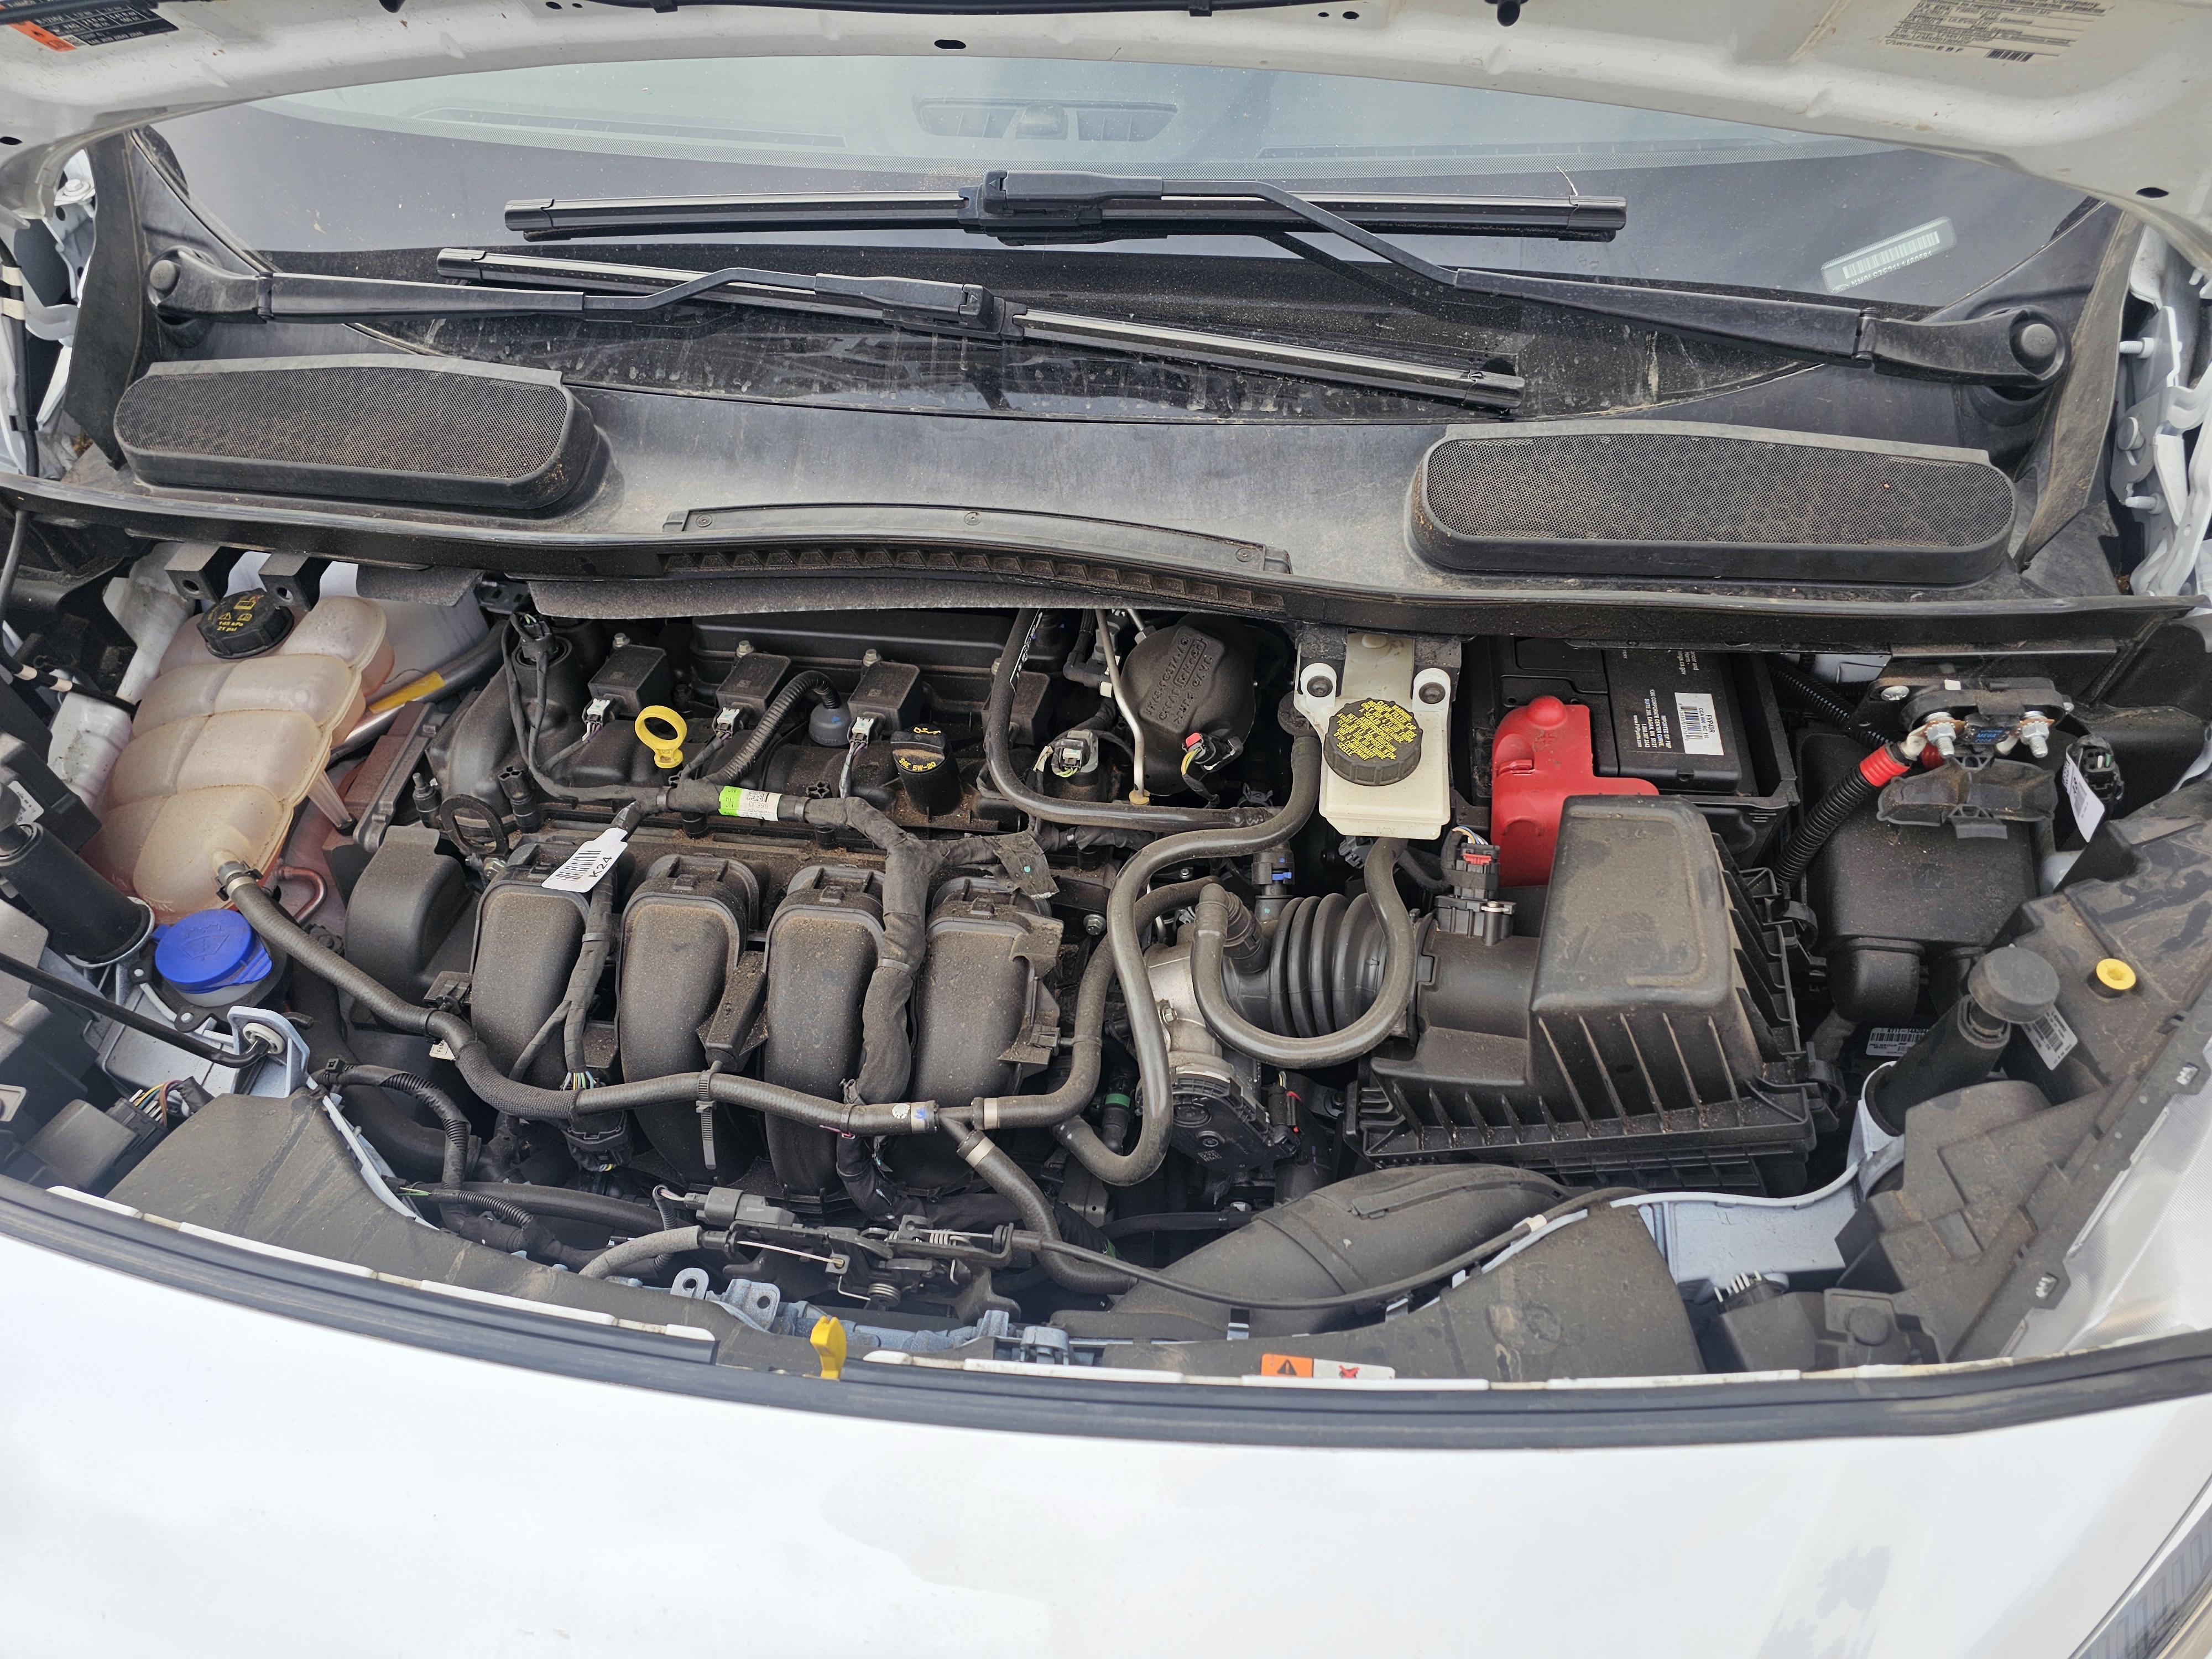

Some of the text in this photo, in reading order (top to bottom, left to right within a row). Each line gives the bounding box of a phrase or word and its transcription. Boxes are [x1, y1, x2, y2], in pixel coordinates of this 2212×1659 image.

[1337, 713, 1353, 724] AVANT
[1364, 712, 1381, 725] SEALED
[1377, 701, 1392, 712] CLEAN
[1391, 711, 1407, 724] FILLER
[1651, 697, 1660, 718] CORPORATE
[1361, 703, 1374, 712] ONLY
[1373, 711, 1383, 719] DOT
[1386, 722, 1400, 733] FLUID
[1399, 732, 1413, 743] FROM
[1368, 700, 1385, 714] BEFORE
[1406, 730, 1417, 739] USE
[1706, 714, 1715, 733] FVP40R
[1337, 719, 1354, 734] PLOYER
[1353, 732, 1363, 741] QUE
[1369, 745, 1387, 760] LIQUIDE
[1337, 727, 1348, 735] DOT
[1350, 738, 1376, 758] PROVENANT
[1347, 713, 1369, 731] NETTOYER
[1375, 735, 1397, 753] BOUCHON
[1333, 732, 1370, 760] D'UN CONTENANT
[899, 758, 936, 771] SAE 5W-20
[726, 797, 734, 808] NG
[588, 855, 613, 878] K24
